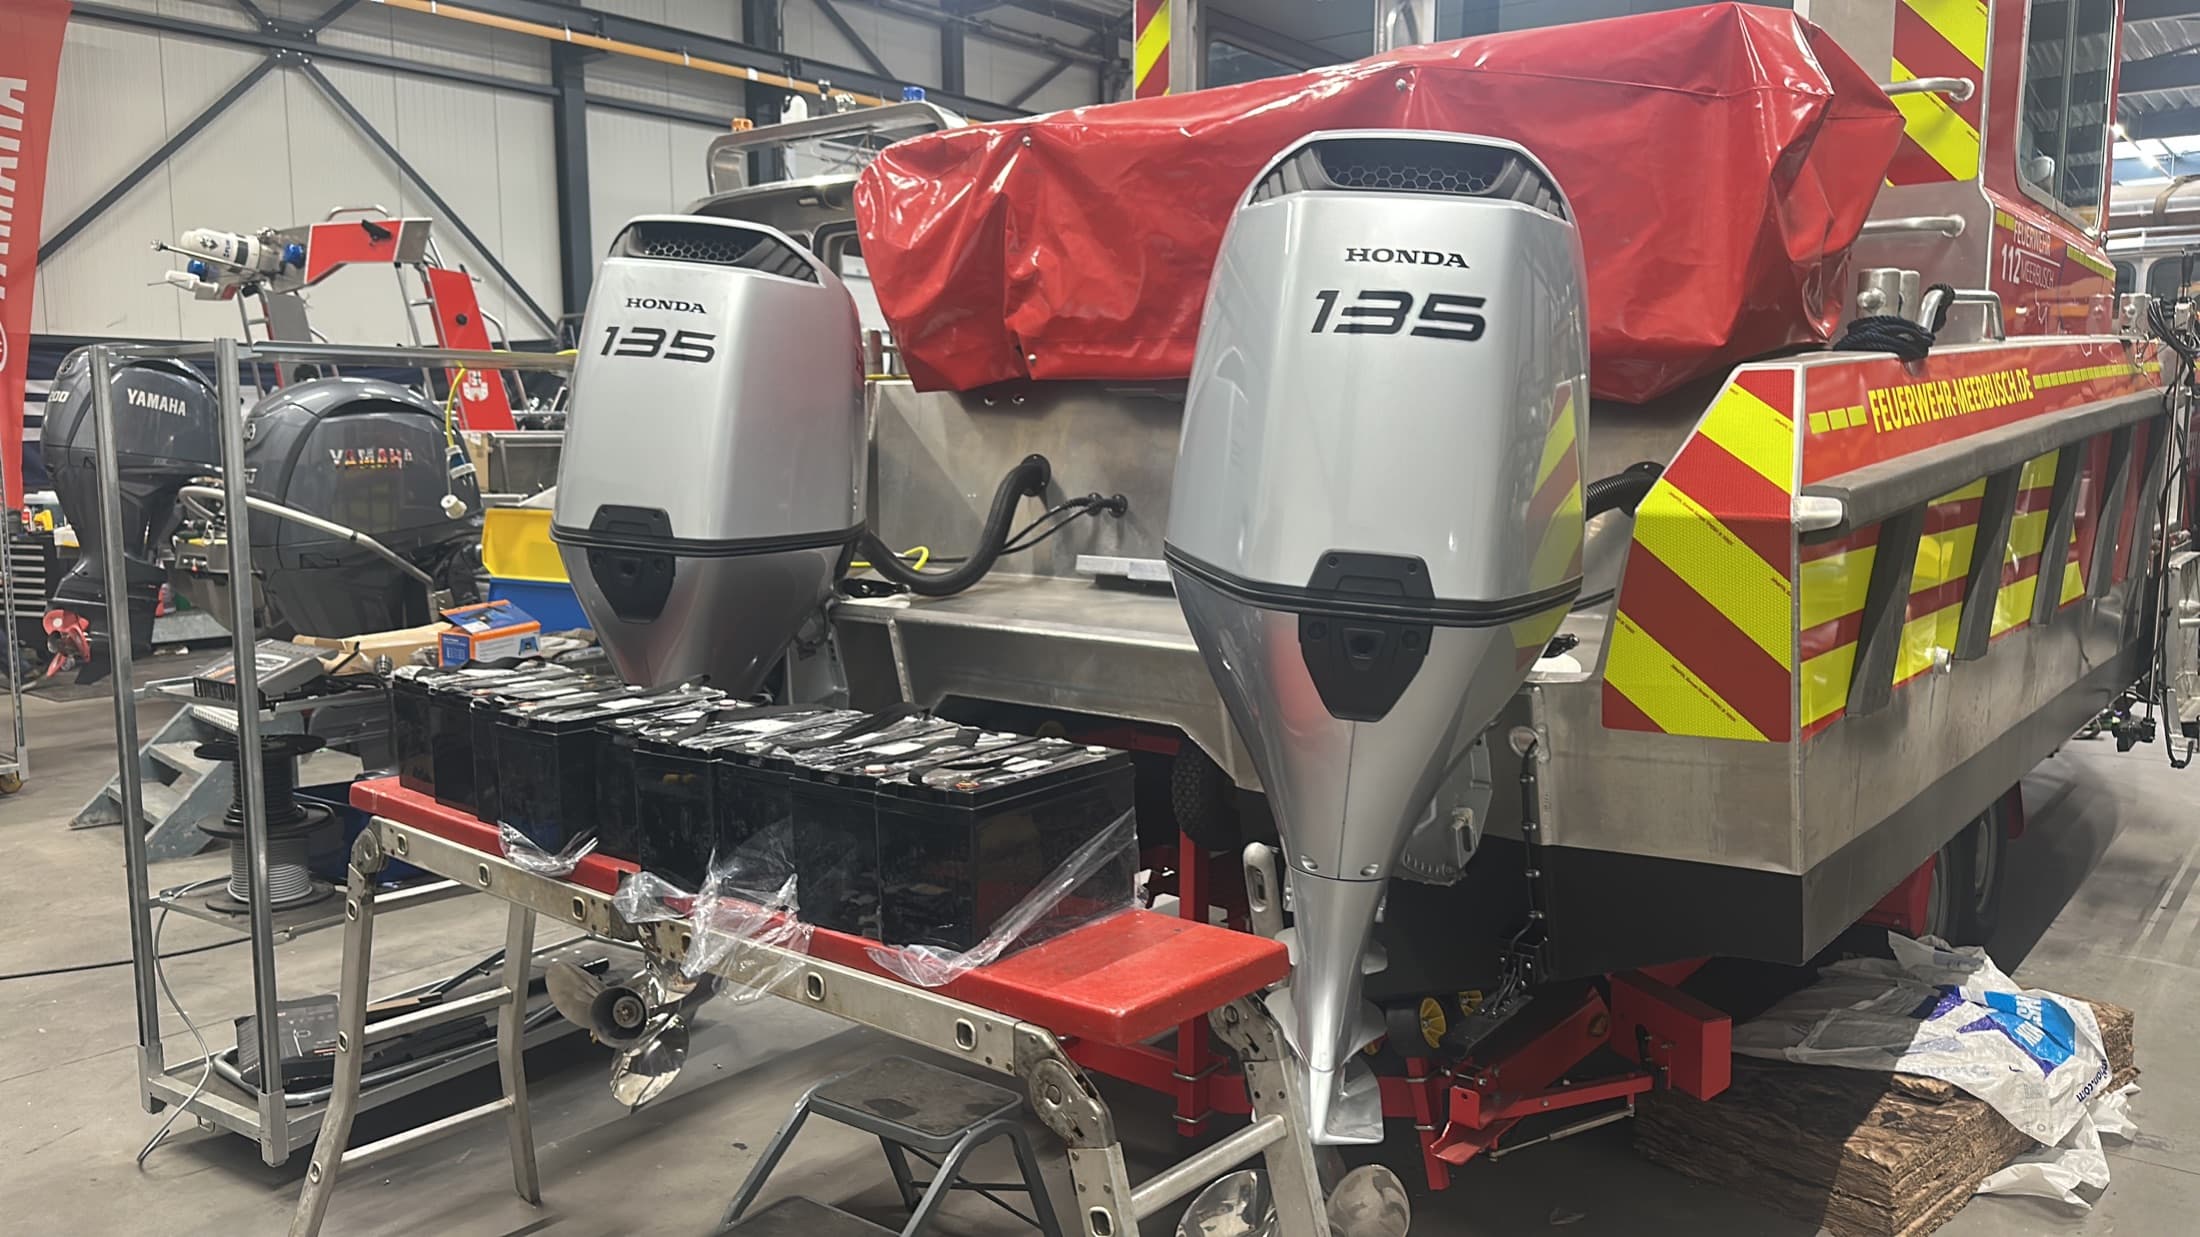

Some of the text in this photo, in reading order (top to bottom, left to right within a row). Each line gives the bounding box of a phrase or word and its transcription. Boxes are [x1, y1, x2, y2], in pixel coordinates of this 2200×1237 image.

[2013, 220, 2051, 256] FEUERWEHR
[1345, 247, 1470, 269] HONDA
[2001, 243, 2020, 284] 112
[2021, 260, 2055, 289] MEERBUSCH
[625, 297, 707, 314] HONDA
[1311, 290, 1487, 342] 135
[600, 326, 717, 364] 135
[127, 388, 187, 416] YAMAHA
[1867, 367, 2035, 433] FEUERWEHR-MEERBUSCH.DE
